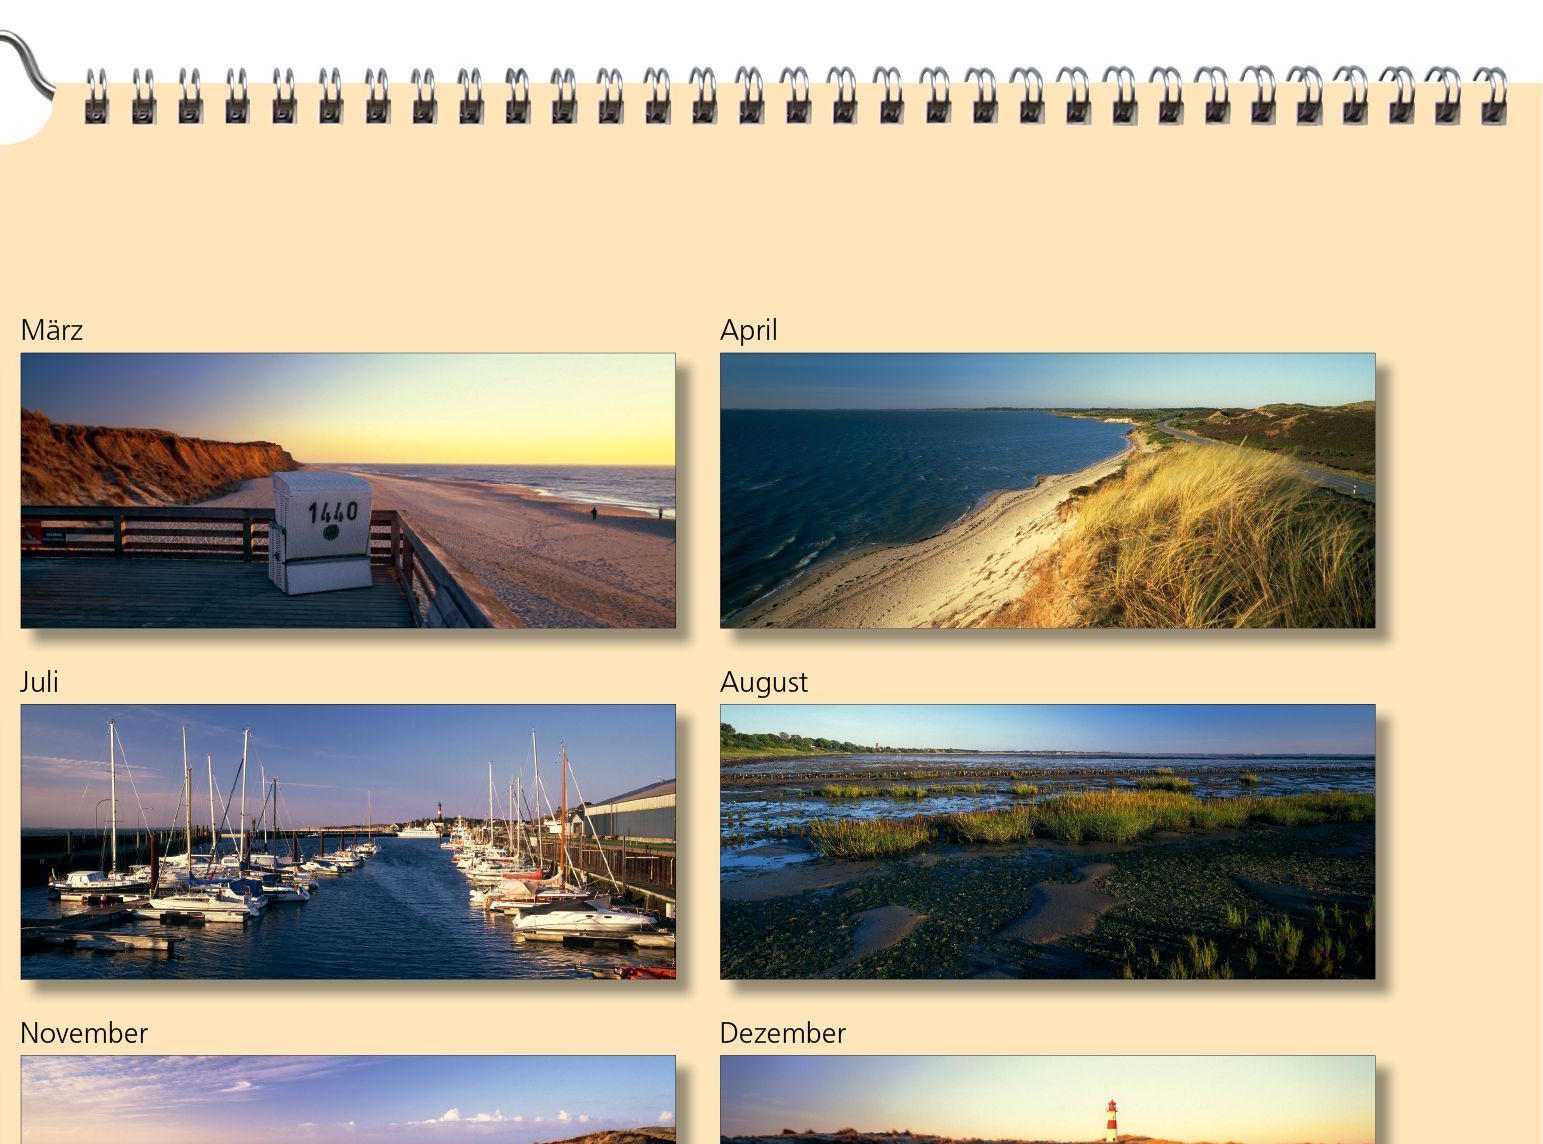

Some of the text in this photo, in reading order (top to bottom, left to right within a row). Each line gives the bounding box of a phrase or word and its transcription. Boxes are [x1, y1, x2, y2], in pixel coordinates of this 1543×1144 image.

[21, 318, 84, 341] März
[719, 317, 777, 347] April
[307, 500, 359, 525] 1440
[19, 669, 58, 693] Juli
[719, 670, 809, 699] August
[21, 1020, 149, 1044] November
[721, 1020, 847, 1044] Dezember
